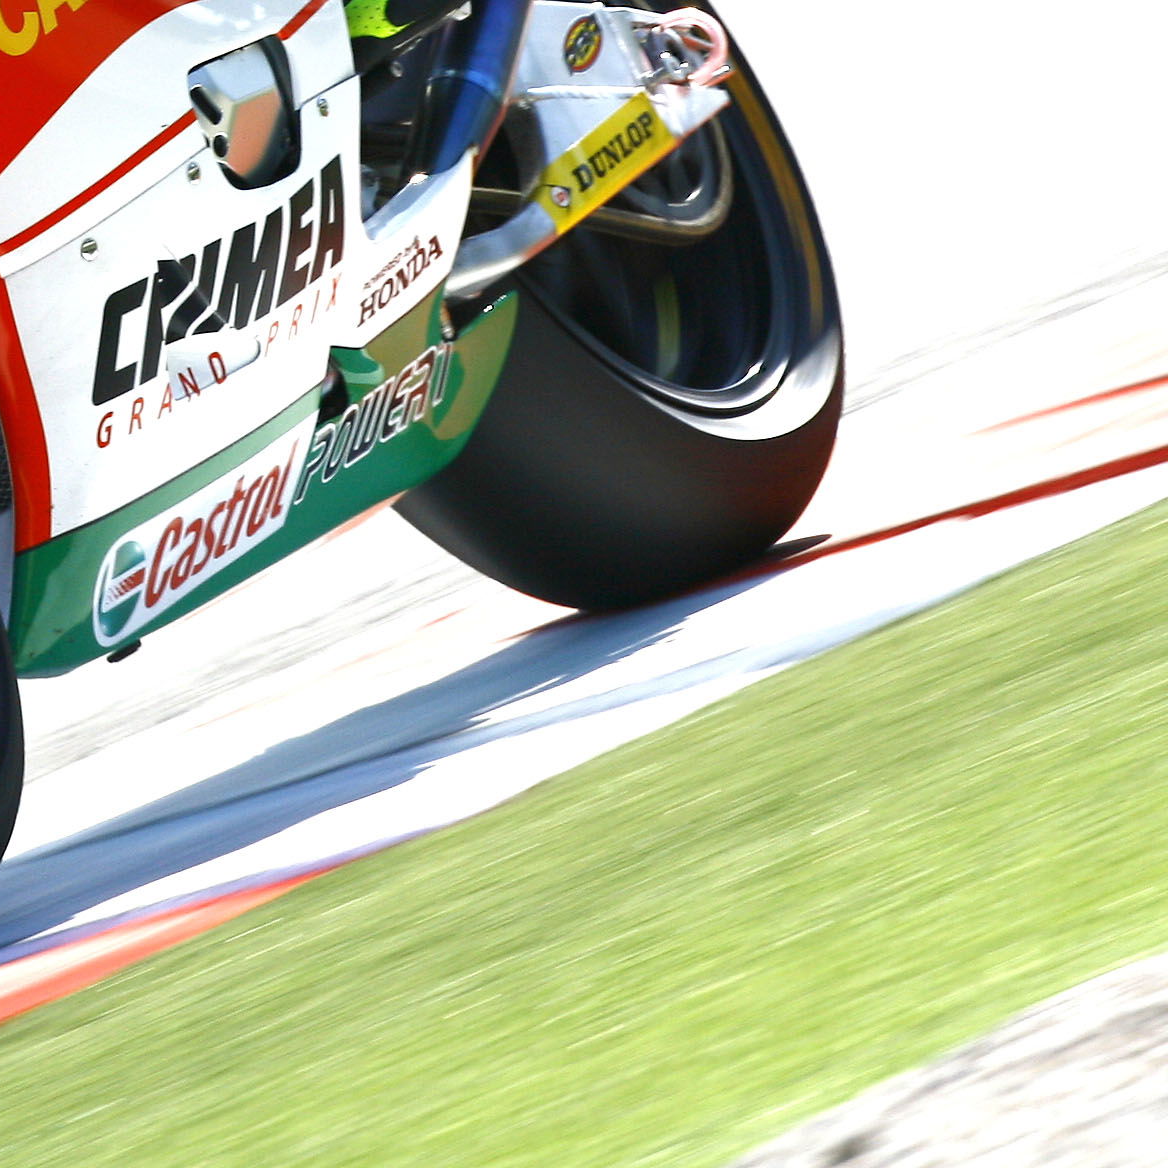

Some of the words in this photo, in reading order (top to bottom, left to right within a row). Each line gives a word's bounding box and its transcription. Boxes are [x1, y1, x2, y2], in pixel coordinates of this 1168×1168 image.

[571, 110, 654, 193] DUNLOP
[90, 153, 347, 406] CRIMEA
[95, 351, 227, 449] GRAND
[264, 273, 345, 359] PRIX
[356, 234, 445, 329] HONDA
[143, 437, 301, 609] Castrol
